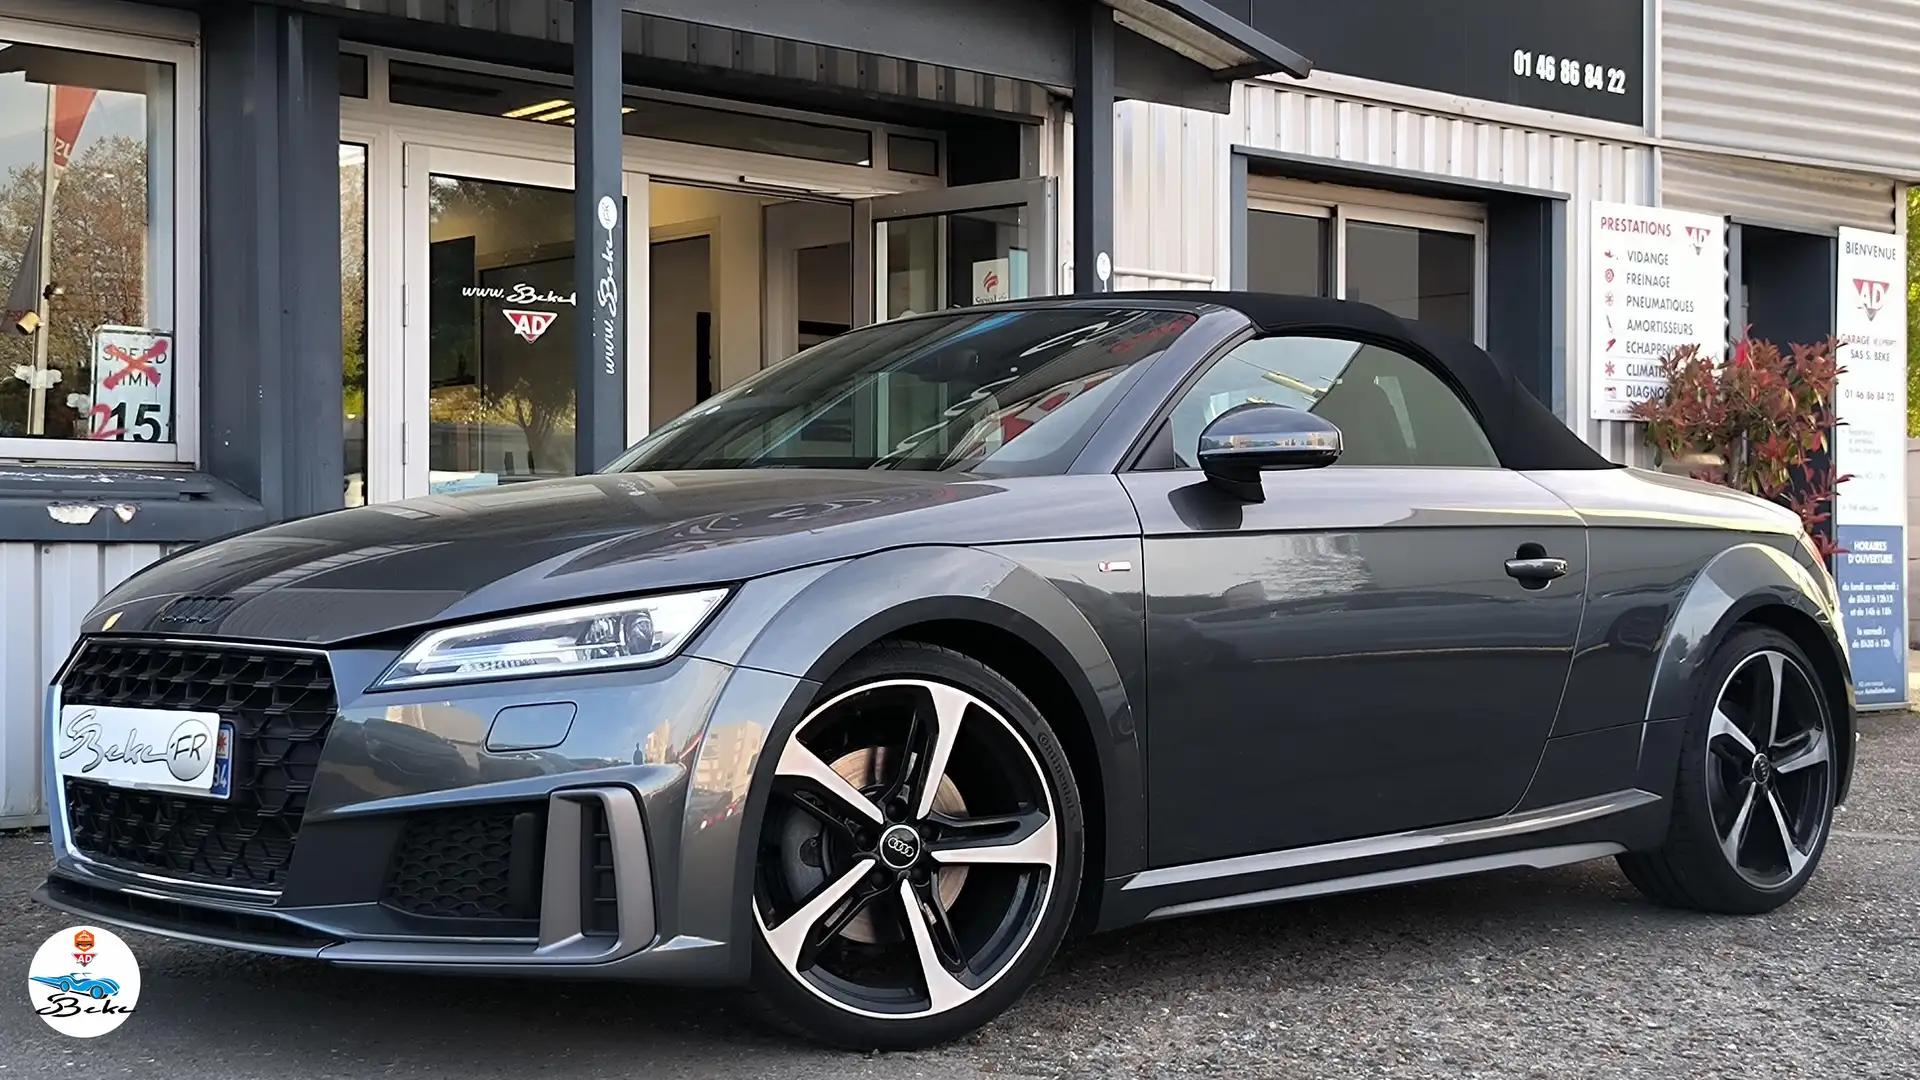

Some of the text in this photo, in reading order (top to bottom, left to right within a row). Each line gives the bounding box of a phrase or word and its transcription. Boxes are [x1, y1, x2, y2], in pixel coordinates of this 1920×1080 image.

[1513, 49, 1626, 95] 01 46 86 84 22
[1600, 216, 1672, 237] PRESTATIONS
[1626, 249, 1669, 266] VIDANGE
[1845, 241, 1896, 260] BIENVENUE
[1626, 272, 1671, 288] FREINAGE
[1626, 294, 1695, 313] PNEUMATIQUES
[1857, 281, 1886, 310] AD
[513, 314, 546, 335] AD
[1626, 318, 1694, 336] AMORTISSEURS
[1841, 333, 1870, 345] GARAGE
[1850, 349, 1864, 360] SAS
[1874, 352, 1890, 362] BEKE
[1844, 389, 1853, 399] 01
[1853, 541, 1887, 551] HORAIRES
[1848, 553, 1893, 564] D'OUVERTURE
